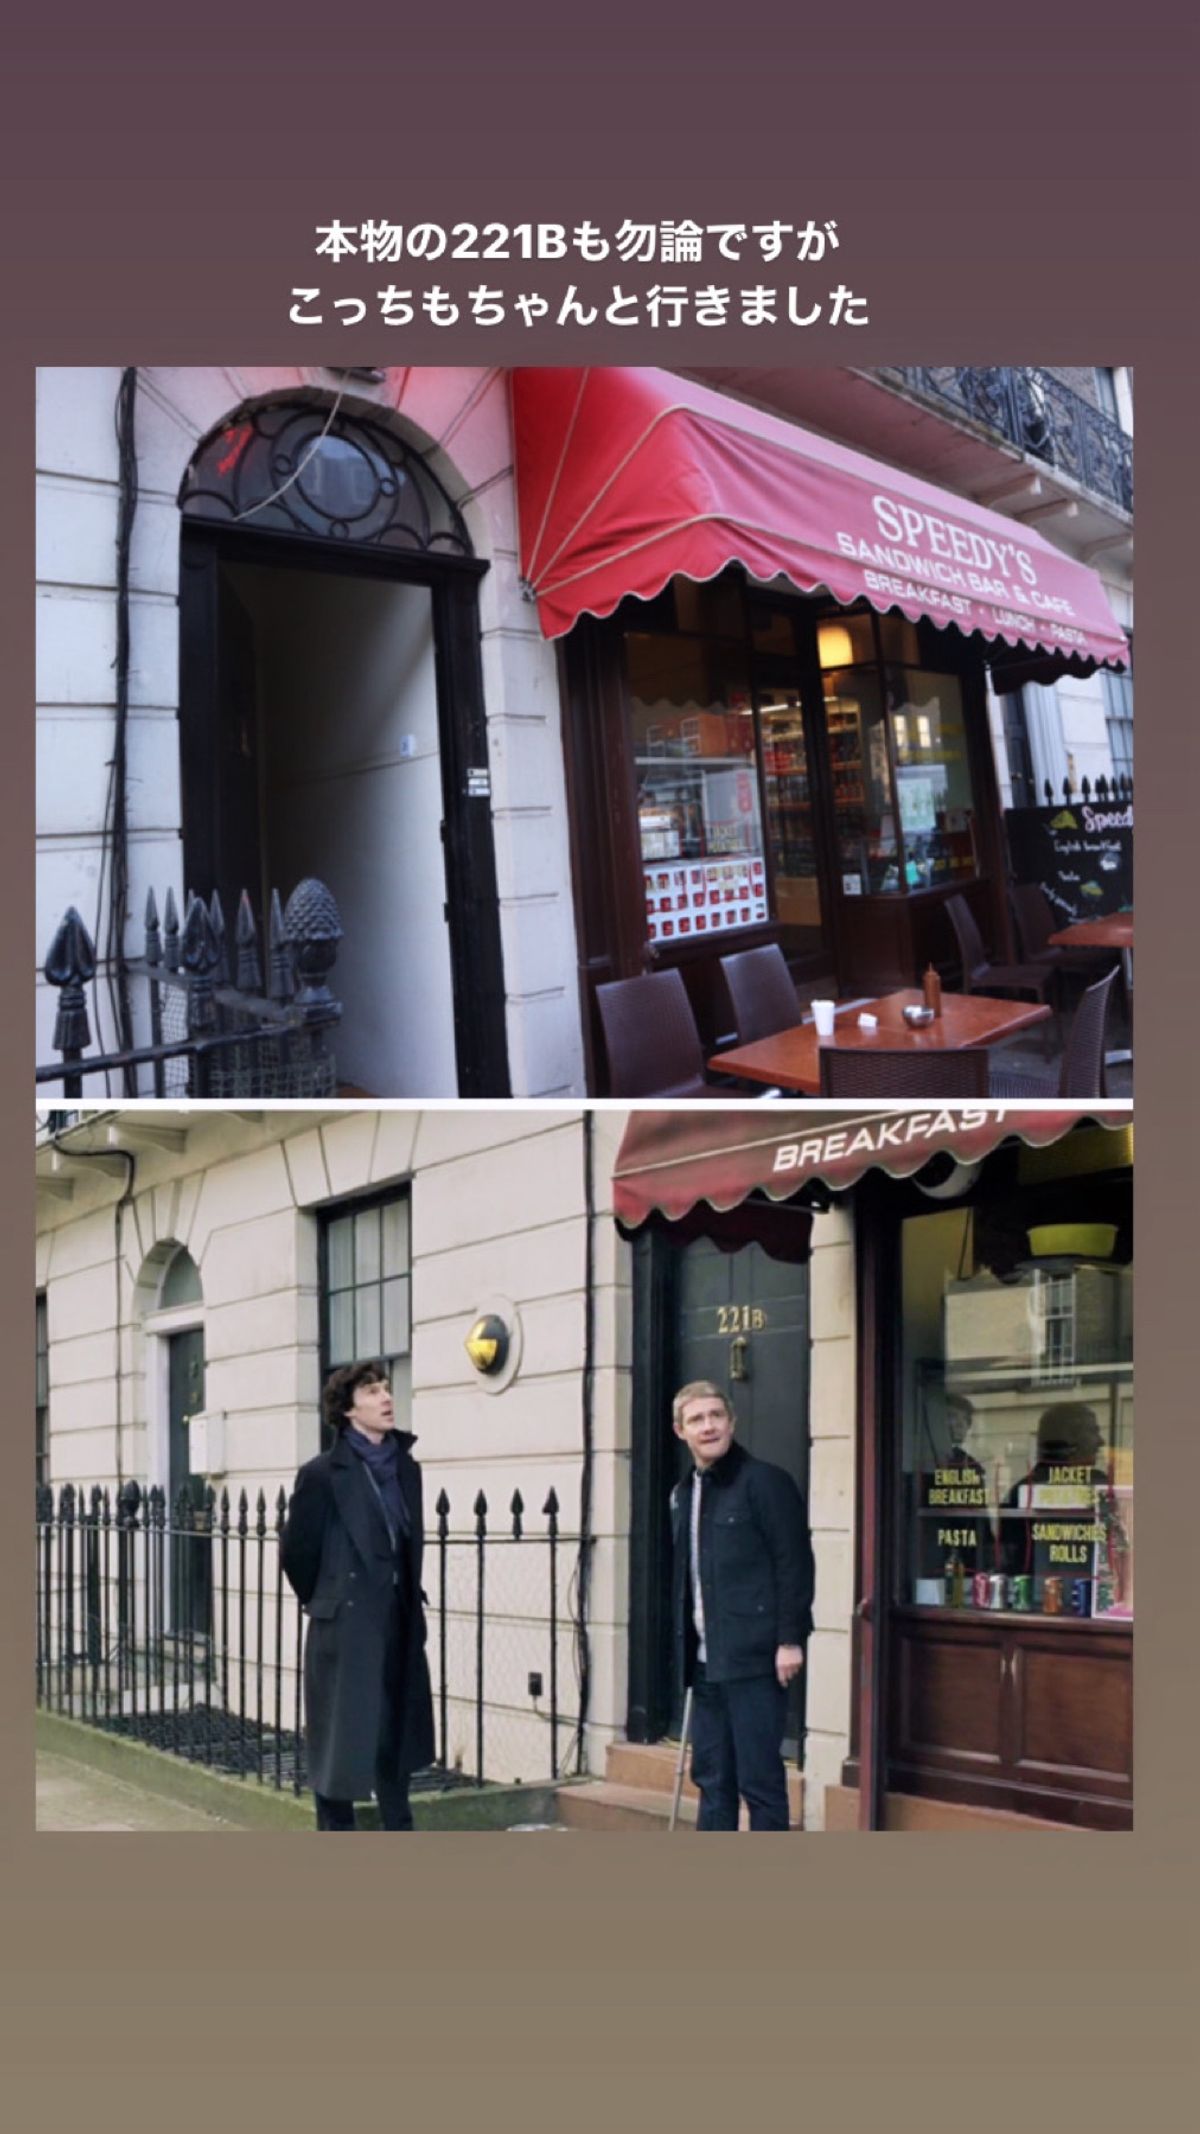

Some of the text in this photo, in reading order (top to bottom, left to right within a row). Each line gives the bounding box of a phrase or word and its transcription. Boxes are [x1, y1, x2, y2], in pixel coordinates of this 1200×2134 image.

[872, 495, 1037, 585] SPEEDY'S
[836, 532, 965, 587] SANDWICH
[969, 571, 1007, 600] BAR
[1012, 585, 1031, 605] &
[863, 569, 1088, 646] BREAKFAST LUNCH PASTA
[718, 1305, 766, 1333] 221B
[1048, 1466, 1092, 1485] JACKET
[938, 1529, 977, 1547] PASTA
[1032, 1524, 1106, 1541] SANDWICHES
[1049, 1545, 1088, 1563] ROLLS
